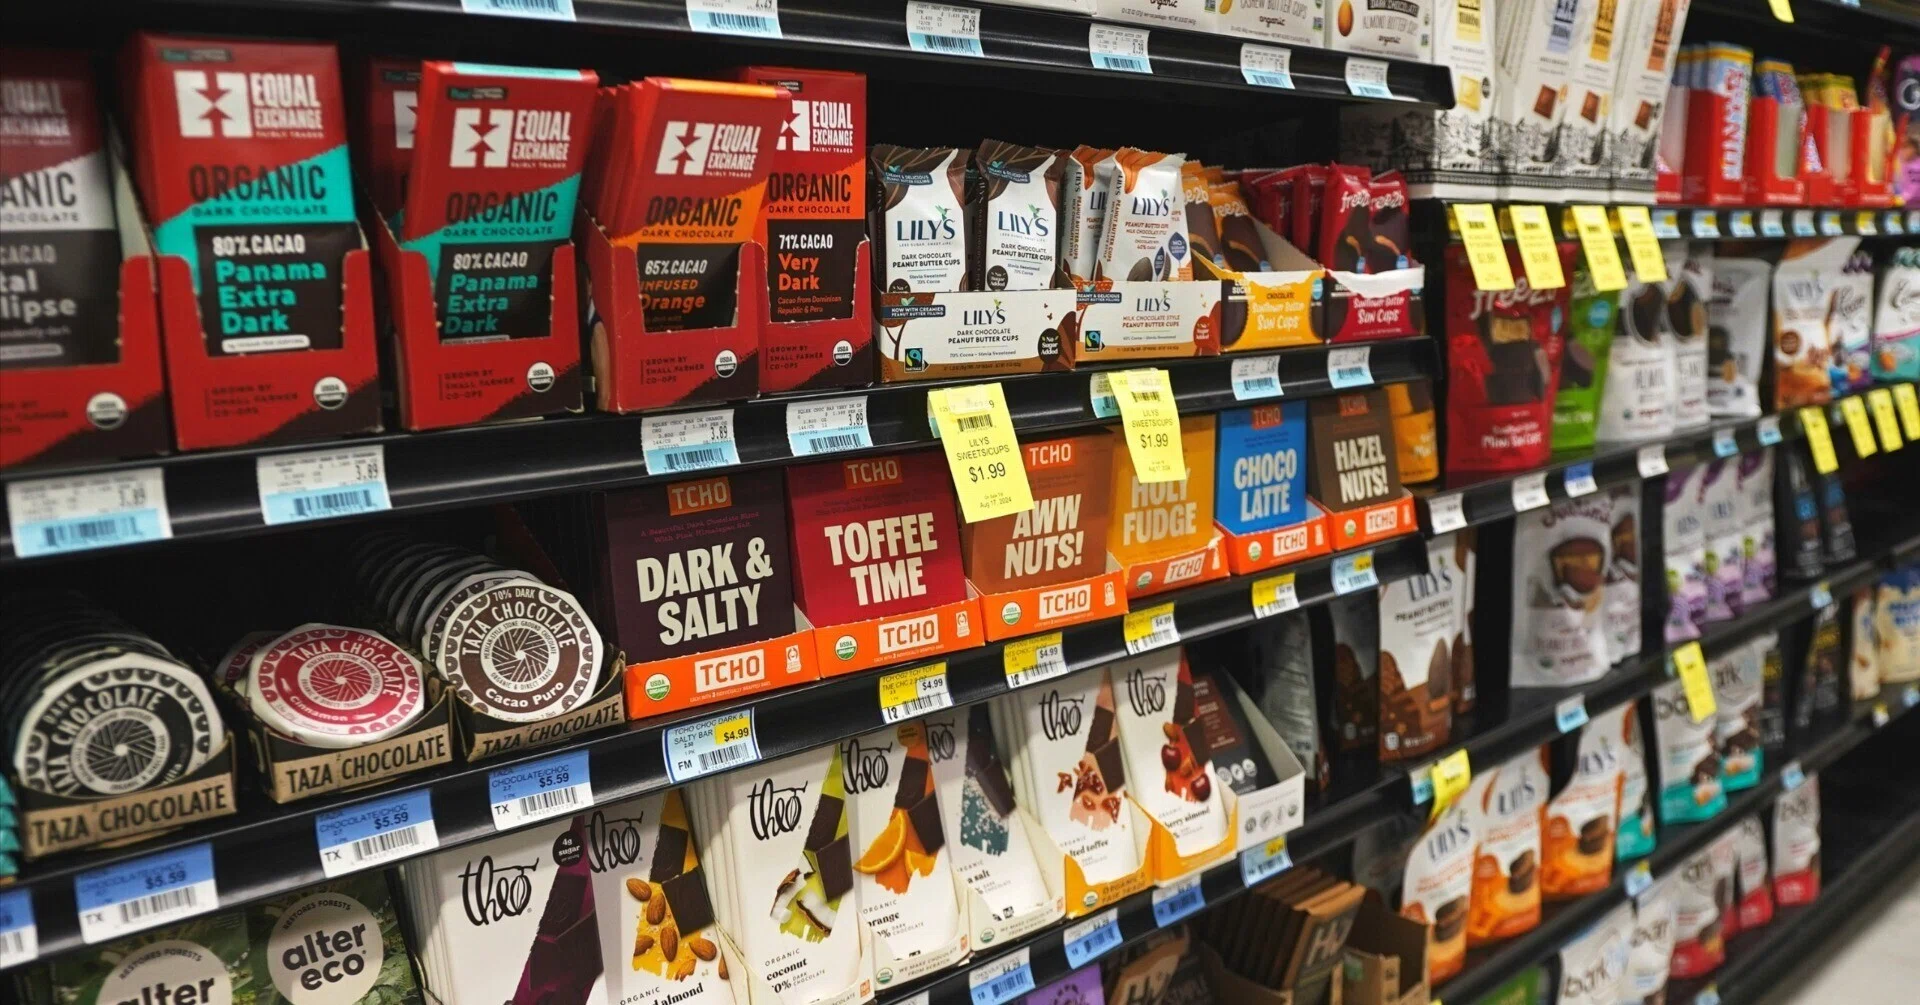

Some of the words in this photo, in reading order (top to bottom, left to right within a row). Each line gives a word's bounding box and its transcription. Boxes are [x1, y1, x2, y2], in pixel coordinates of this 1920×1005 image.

[962, 19, 976, 32] 2.29
[1259, 16, 1286, 28] organic
[1378, 35, 1401, 45] organic
[250, 73, 321, 106] EQUAL
[254, 109, 324, 131] EXCHANGE
[514, 110, 571, 142] EQUAL
[812, 101, 854, 131] EQUAL
[712, 124, 761, 153] EQUAL
[812, 128, 854, 147] EXCHANGE
[511, 142, 570, 161] EXCHANGE
[708, 152, 757, 171] EXCHANGE
[189, 164, 327, 202] ORGANIC
[768, 173, 851, 202] ORGANIC
[445, 191, 558, 224] ORGANIC
[645, 196, 742, 227] ORGANIC
[768, 205, 794, 214] DARK
[798, 205, 851, 214] CHOCOLATE
[443, 227, 477, 237] DARK
[482, 226, 554, 237] CHOCOLATE
[642, 229, 670, 238] DARK
[674, 230, 735, 239] CHOCOLATE
[1125, 221, 1144, 229] PEANUT
[212, 235, 250, 256] 80%
[252, 233, 306, 255] CACAO
[992, 249, 1017, 257] PEANUT
[1017, 252, 1038, 260] BUTTER
[1039, 254, 1053, 262] CUPS
[1017, 244, 1047, 253] CHOCOLATE
[452, 252, 483, 270] 80%
[484, 251, 528, 269] CACAO
[778, 253, 820, 273] Very
[918, 252, 952, 260] CHOCOLATE
[215, 260, 327, 283] Panama
[778, 273, 820, 291] Dark
[450, 273, 538, 294] Panama
[218, 285, 297, 309] Extra
[449, 295, 509, 314] Extra
[777, 297, 796, 305] Cacao
[797, 296, 811, 304] from
[812, 295, 842, 304] Dominican
[1266, 292, 1295, 300] CHOCOLATE
[221, 310, 289, 335] Dark
[444, 315, 498, 335] Dark
[1041, 342, 1058, 350] Sugar
[1131, 417, 1174, 429] SWEETS/CUPS
[1142, 408, 1159, 418] LILYS
[1253, 405, 1281, 426] TCHO
[968, 436, 990, 448] LILYS
[1140, 432, 1169, 450] $1.99
[1029, 443, 1072, 466] TCHO
[1333, 434, 1386, 472] HAZEL
[847, 459, 899, 485] TCHO
[968, 462, 1006, 484] $1.99
[1233, 449, 1298, 490] CHOCO
[672, 481, 728, 510] TCHO
[1339, 471, 1390, 504] NUTS!
[1240, 482, 1291, 522] LATTE
[1012, 494, 1082, 540] AWW
[1123, 502, 1198, 546] FUDGE
[1368, 509, 1396, 529] TCHO
[824, 512, 938, 566] TOFFEE
[1276, 529, 1306, 554] TCHO
[1003, 531, 1083, 579] NUTS!
[636, 543, 734, 602] DARK
[745, 536, 773, 580] &
[1168, 558, 1203, 581] TCHO
[850, 557, 928, 606] TIME
[1043, 590, 1087, 614] TCHO
[491, 600, 576, 649] CHOCOLATE
[658, 584, 762, 647] SALTY
[462, 619, 492, 656] TAZA
[882, 619, 935, 648] TCHO
[289, 641, 332, 663] TAZA
[1039, 647, 1058, 659] $4.99
[339, 640, 404, 698] CHOCOLATE
[699, 654, 760, 686] TCHO
[485, 687, 529, 708] Cacao
[531, 680, 565, 706] Puro
[650, 679, 665, 687] USDA
[922, 677, 944, 690] $4.99
[290, 695, 349, 722] Cinnamon
[1039, 689, 1086, 742] theo
[481, 732, 522, 757] TAZA
[528, 702, 621, 745] CHOCOLATE
[672, 726, 694, 736] TCHO
[695, 720, 718, 732] CHOC
[718, 714, 738, 725] DARK
[723, 727, 750, 743] $4.99
[673, 733, 697, 746] SALTY
[697, 729, 713, 739] BAR
[285, 763, 333, 795] TAZA
[341, 733, 446, 782] CHOCOLATE
[677, 759, 693, 771] FM
[491, 764, 570, 788] CHOCOLATE/CHOC
[539, 772, 570, 788] $5.59
[32, 815, 90, 846] TAZA
[99, 784, 227, 831] CHOCOLATE
[494, 803, 510, 815] TX
[747, 778, 809, 841] theo
[1184, 807, 1211, 822] almond
[374, 811, 409, 830] $5.59
[561, 838, 573, 846] 4g
[324, 850, 342, 863] TX
[973, 869, 990, 882] salt
[458, 855, 540, 927] theo
[281, 902, 317, 931] RESTORES
[317, 899, 351, 911] FORESTS
[862, 899, 898, 915] ORGANIC
[84, 913, 104, 925] TX
[282, 921, 366, 971] alter
[764, 948, 801, 967] ORGANIC
[908, 968, 924, 977] FROM
[925, 958, 951, 971] SCRATCH
[300, 951, 366, 991] eco
[766, 957, 808, 982] coconut
